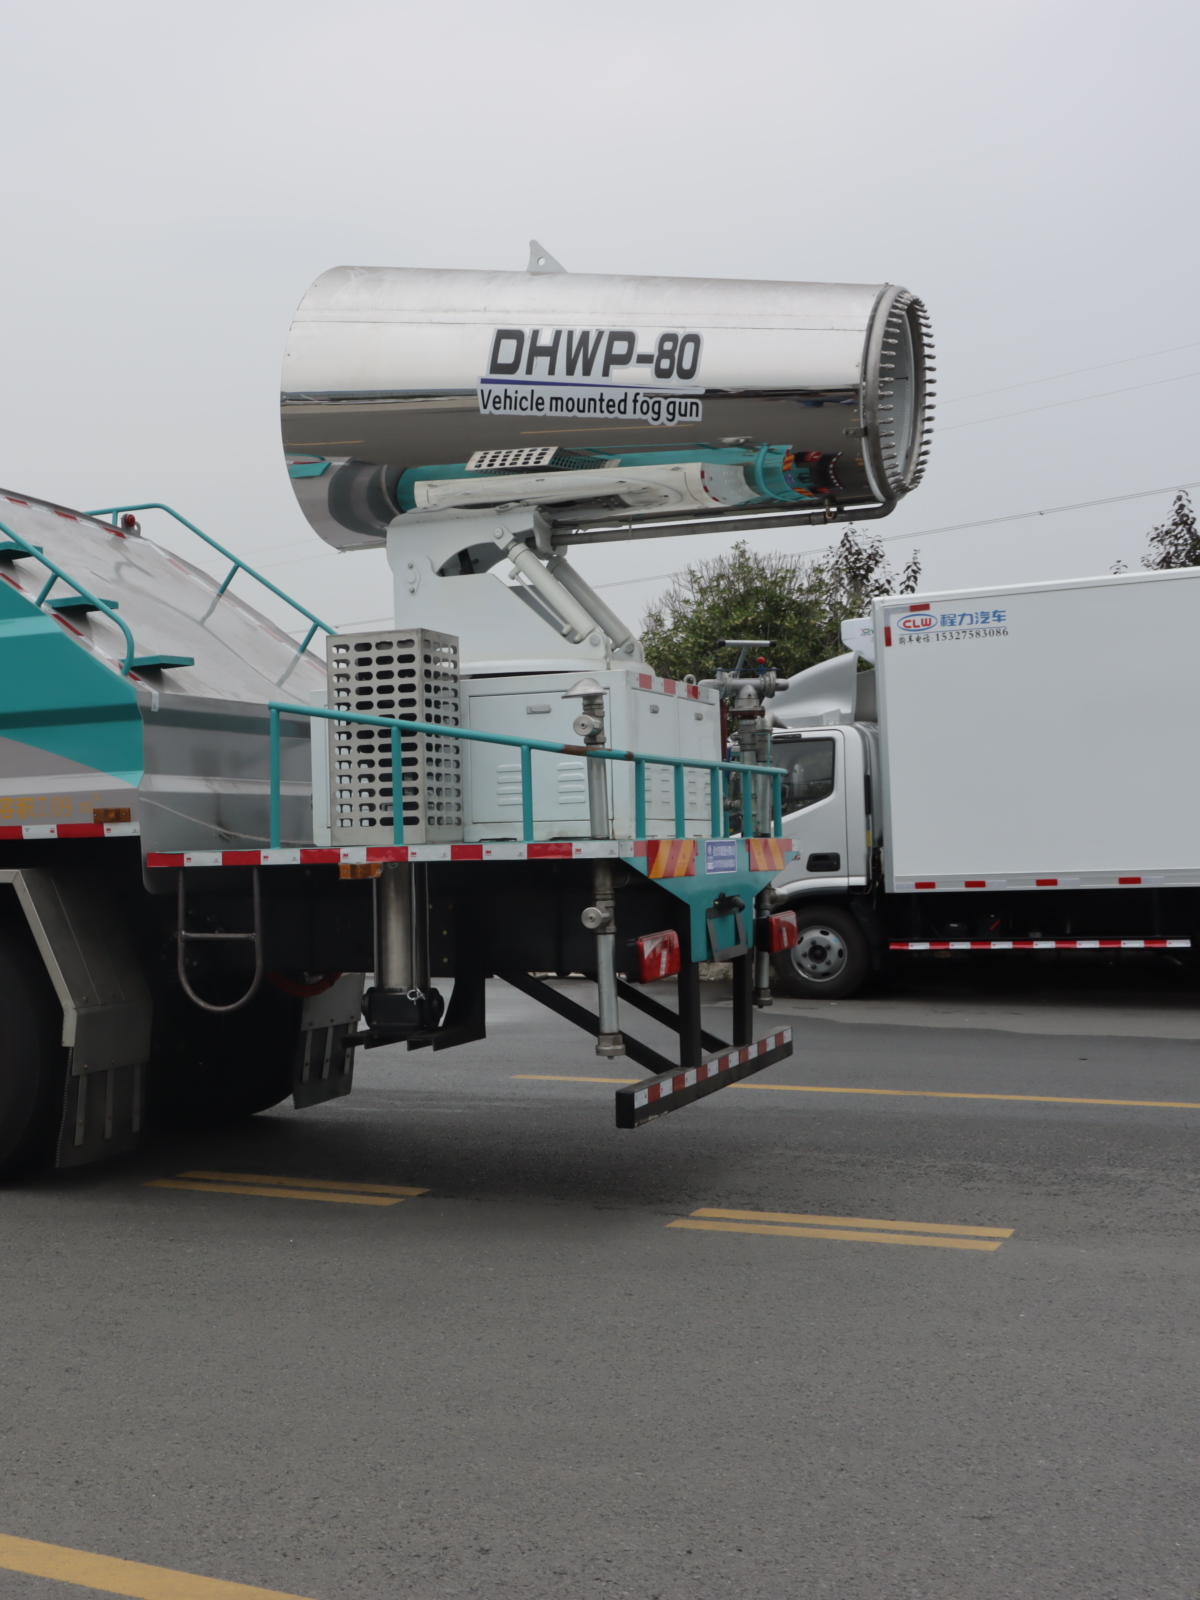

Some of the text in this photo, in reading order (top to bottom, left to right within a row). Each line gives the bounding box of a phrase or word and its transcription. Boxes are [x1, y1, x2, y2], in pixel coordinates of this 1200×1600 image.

[489, 329, 701, 380] DHWP-80
[480, 388, 700, 422] Vehicle mounted fog gun
[903, 618, 932, 629] CLW
[940, 610, 1007, 627] 程力汽车
